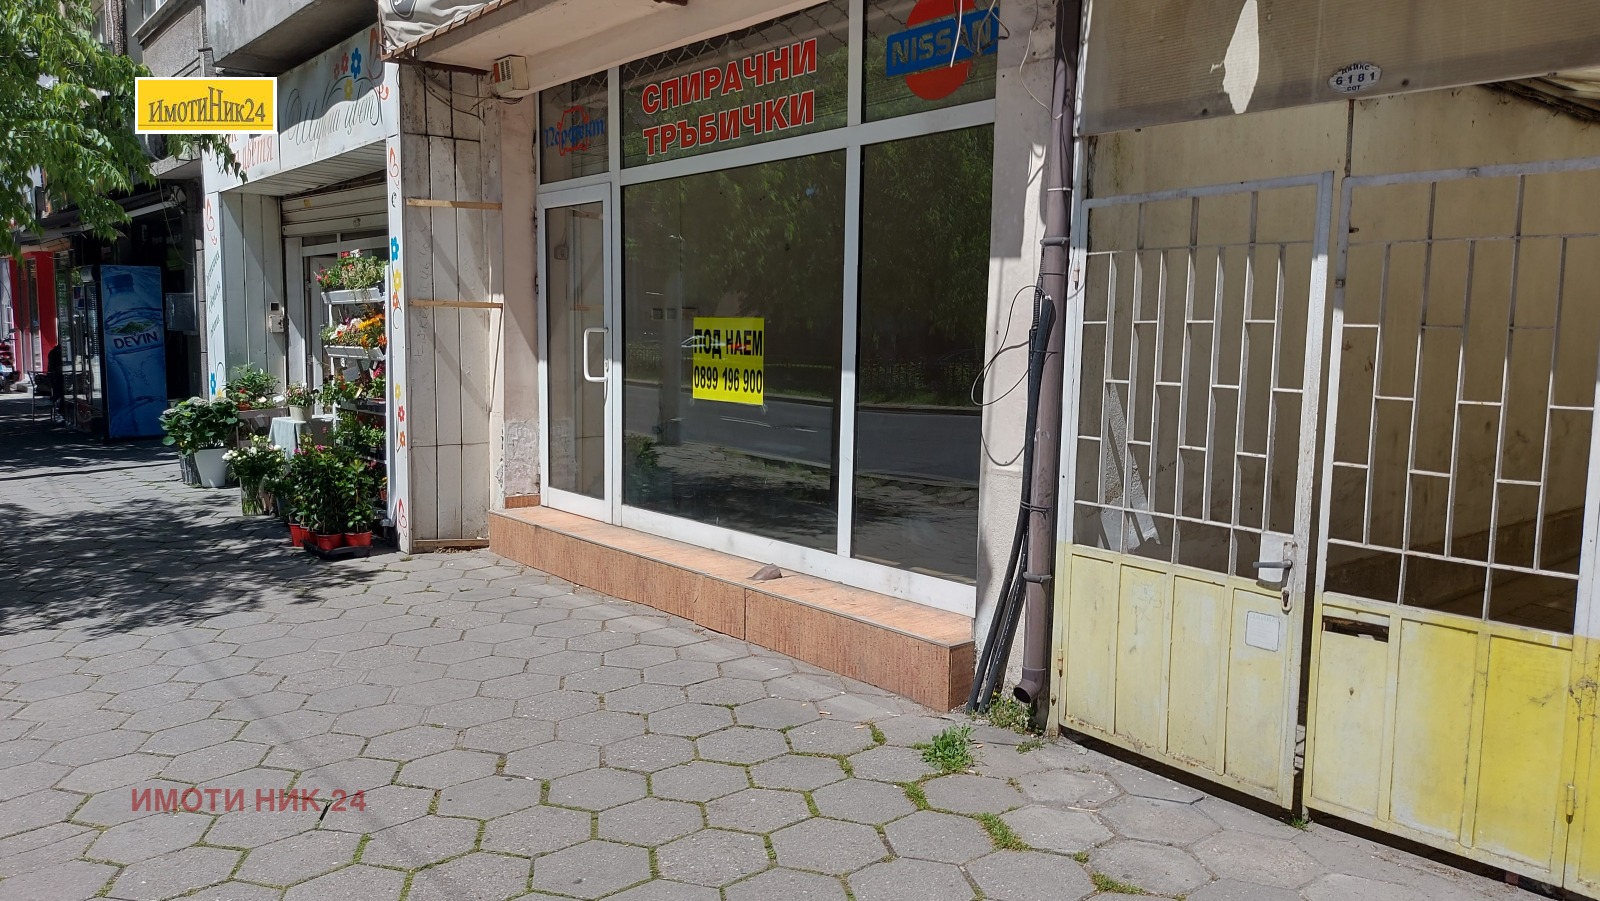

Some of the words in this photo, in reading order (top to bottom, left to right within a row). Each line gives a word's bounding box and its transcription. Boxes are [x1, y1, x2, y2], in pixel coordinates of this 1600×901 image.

[891, 18, 992, 67] NISSAN
[641, 37, 817, 114] СПИРАЧНИ
[1335, 71, 1375, 85] 6181
[643, 89, 815, 156] ТРЪБИЧКИ
[113, 331, 159, 349] DEVIN
[694, 329, 721, 359] ПОД
[726, 329, 763, 356] НАЕМ
[694, 366, 718, 390] 0899
[723, 367, 740, 392] 196
[743, 368, 763, 394] 900
